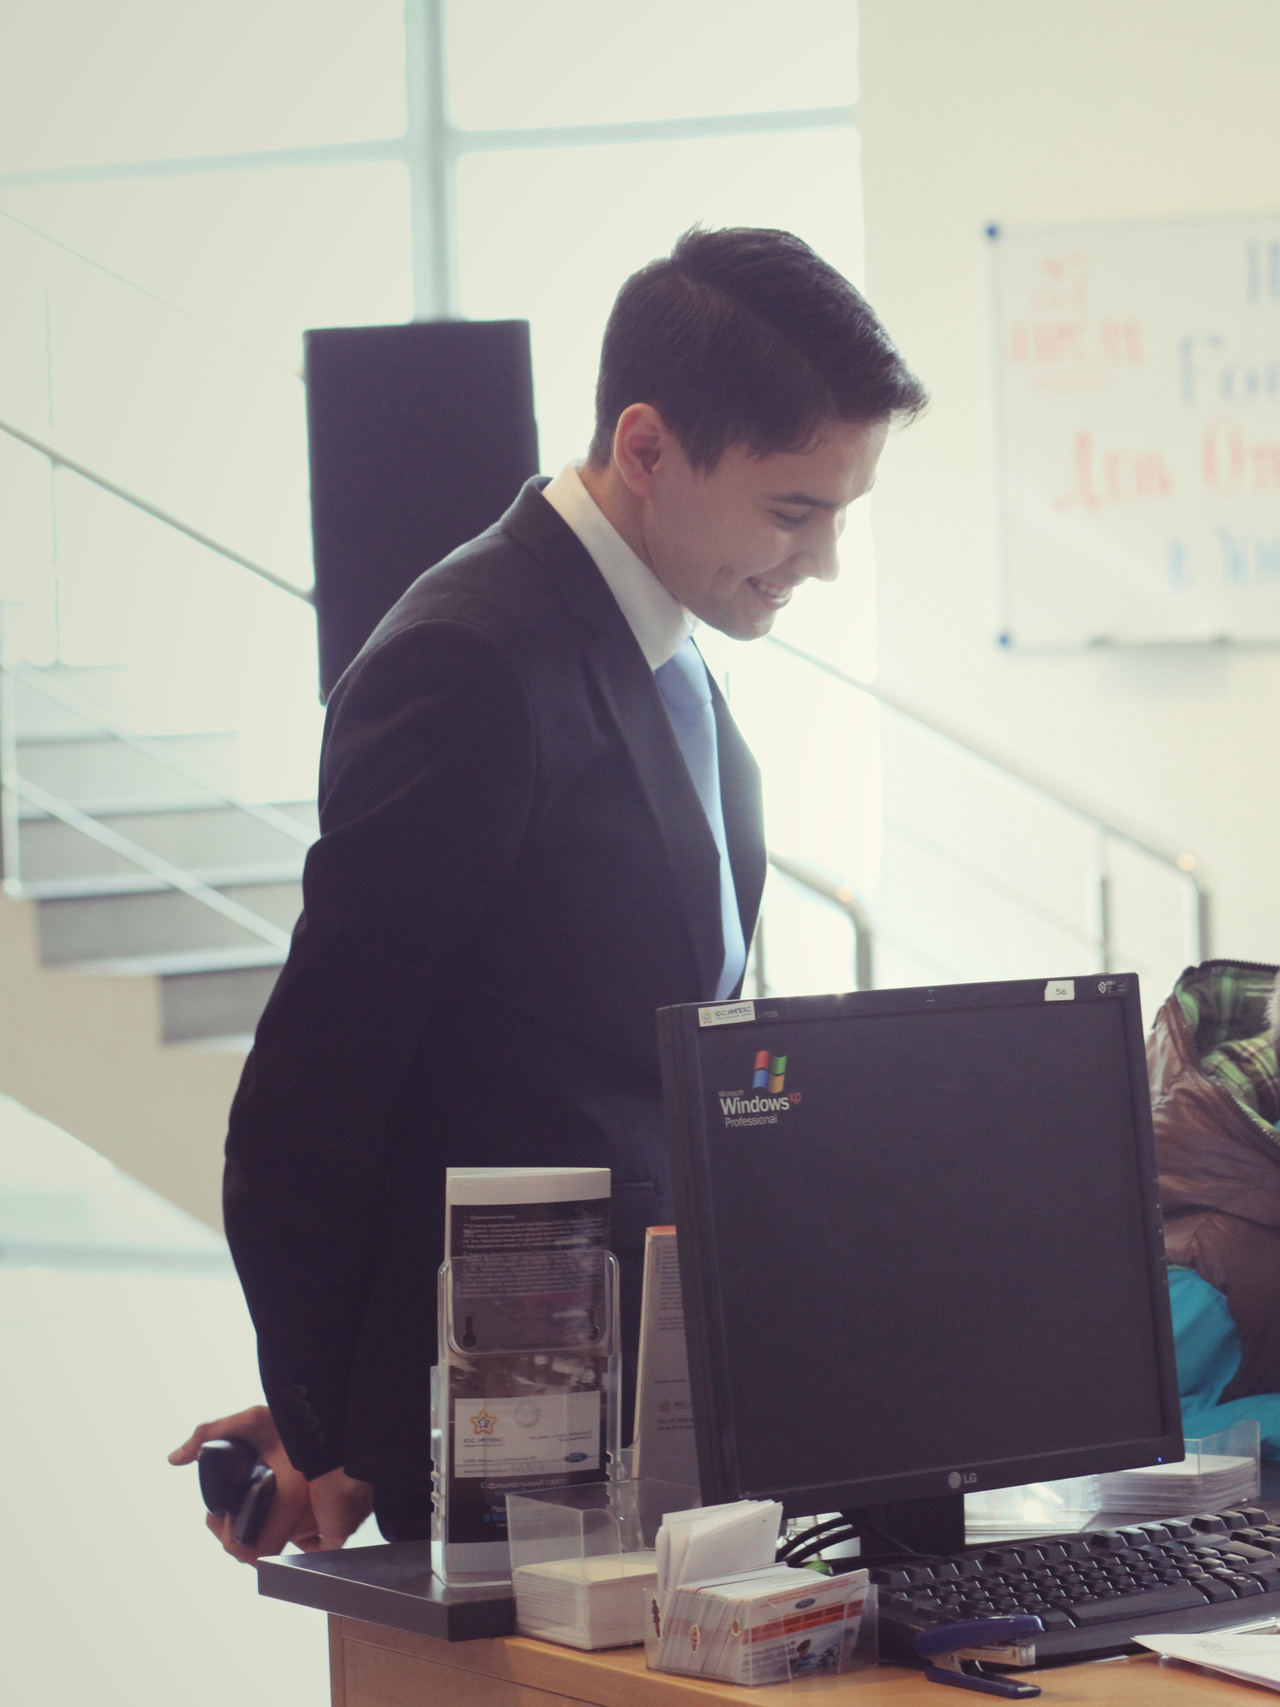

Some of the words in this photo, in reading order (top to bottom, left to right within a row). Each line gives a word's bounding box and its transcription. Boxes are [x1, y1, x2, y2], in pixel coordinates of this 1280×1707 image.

[1055, 988, 1067, 996] S6
[719, 1095, 790, 1115] Windows
[724, 1113, 778, 1127] Professional
[963, 1472, 977, 1484] LG
